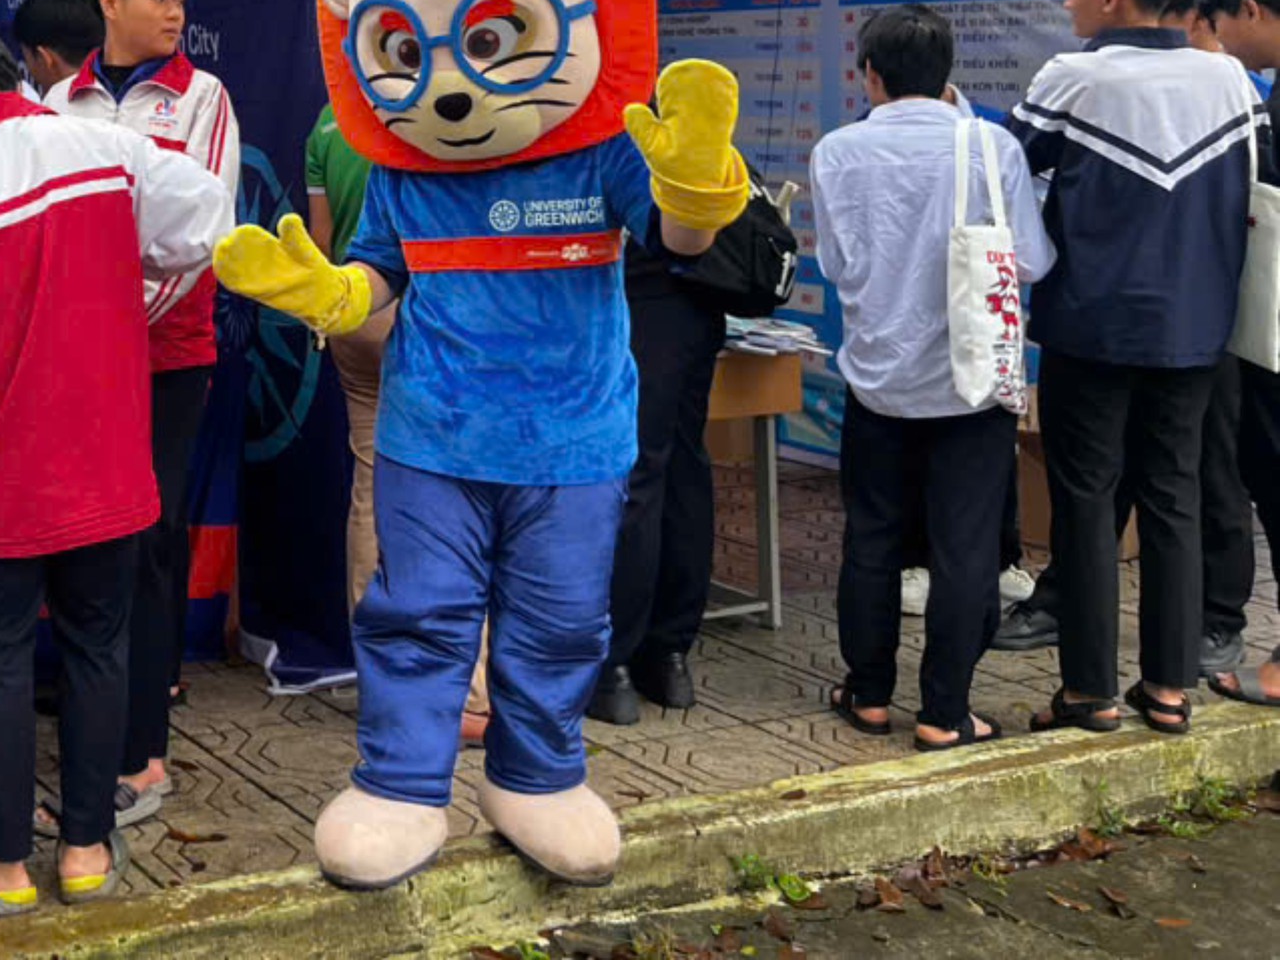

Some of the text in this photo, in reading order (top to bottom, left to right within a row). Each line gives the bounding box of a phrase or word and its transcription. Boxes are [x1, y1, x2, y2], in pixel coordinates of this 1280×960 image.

[188, 23, 220, 61] City
[523, 196, 603, 213] UNIVERSITY OF
[525, 208, 605, 227] GREENWICH
